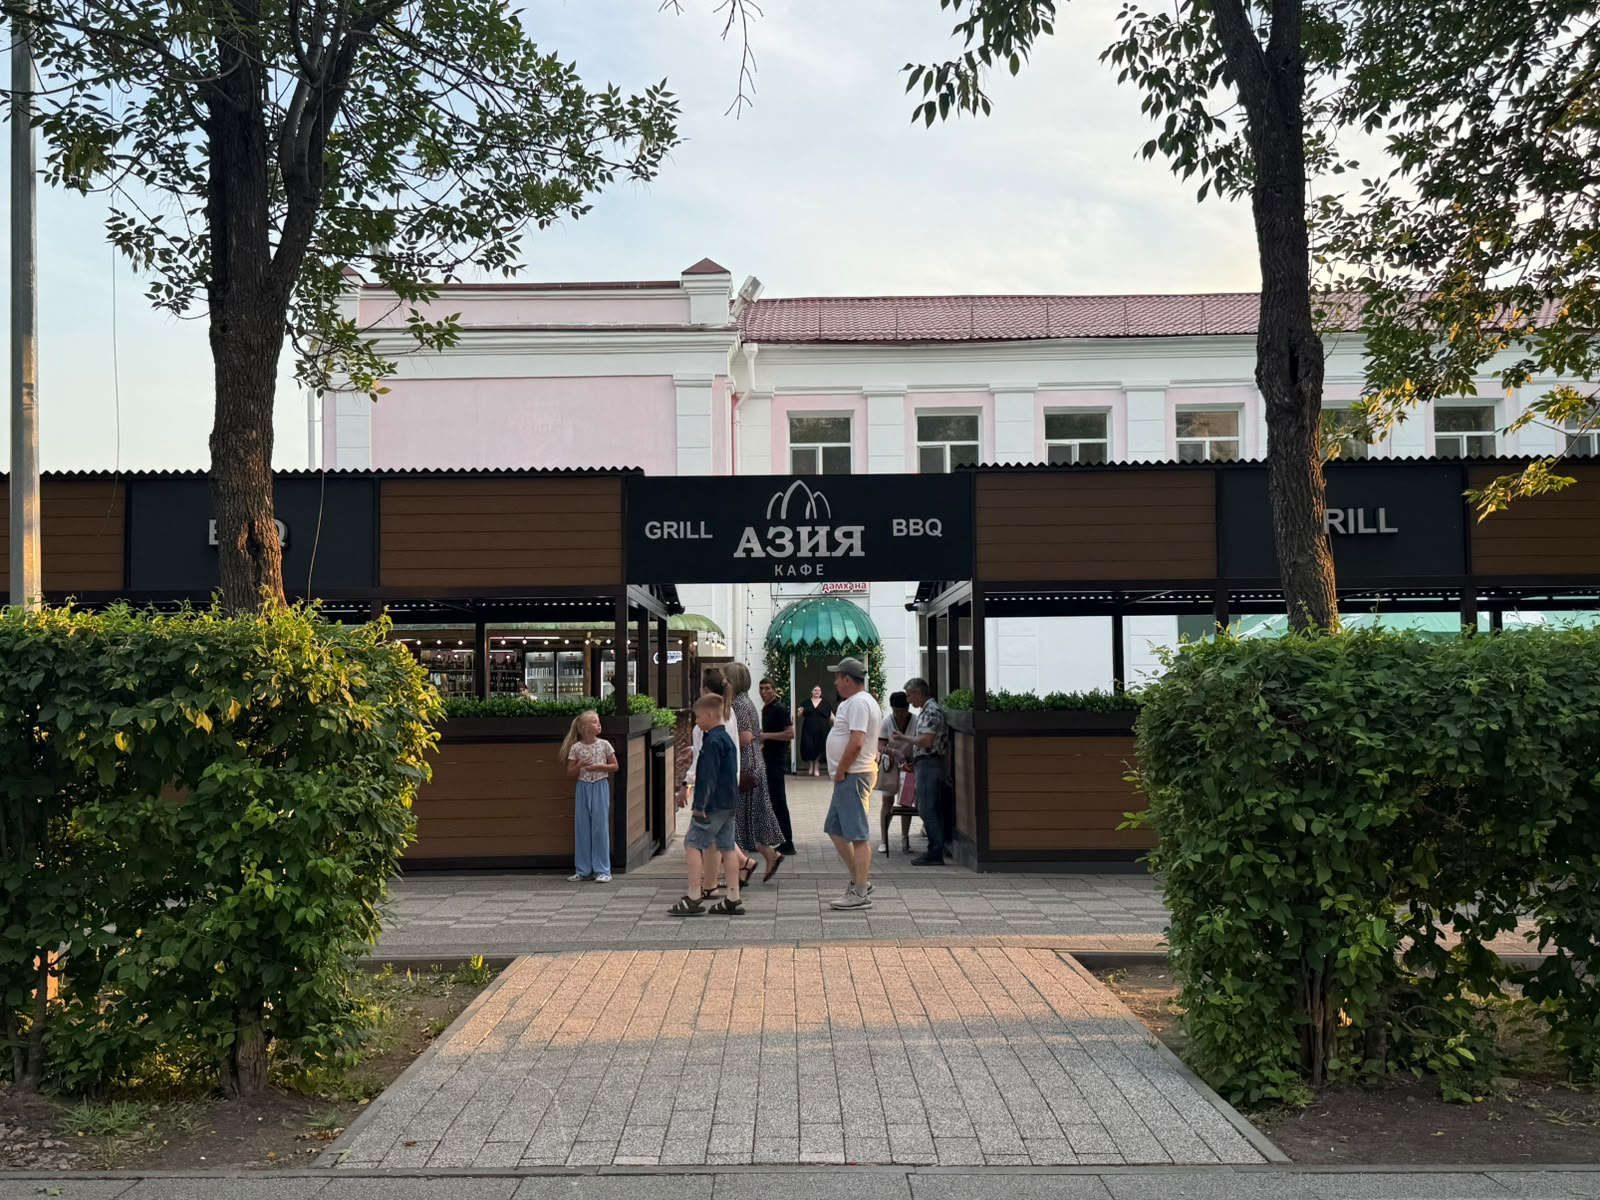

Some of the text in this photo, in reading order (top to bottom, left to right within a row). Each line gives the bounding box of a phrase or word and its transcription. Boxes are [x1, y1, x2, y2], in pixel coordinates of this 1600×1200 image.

[645, 520, 713, 539] GRILL
[892, 517, 943, 537] BBQ
[1324, 507, 1399, 534] RILL
[733, 525, 866, 558] АЗИЯ
[774, 563, 825, 576] КАФЕ
